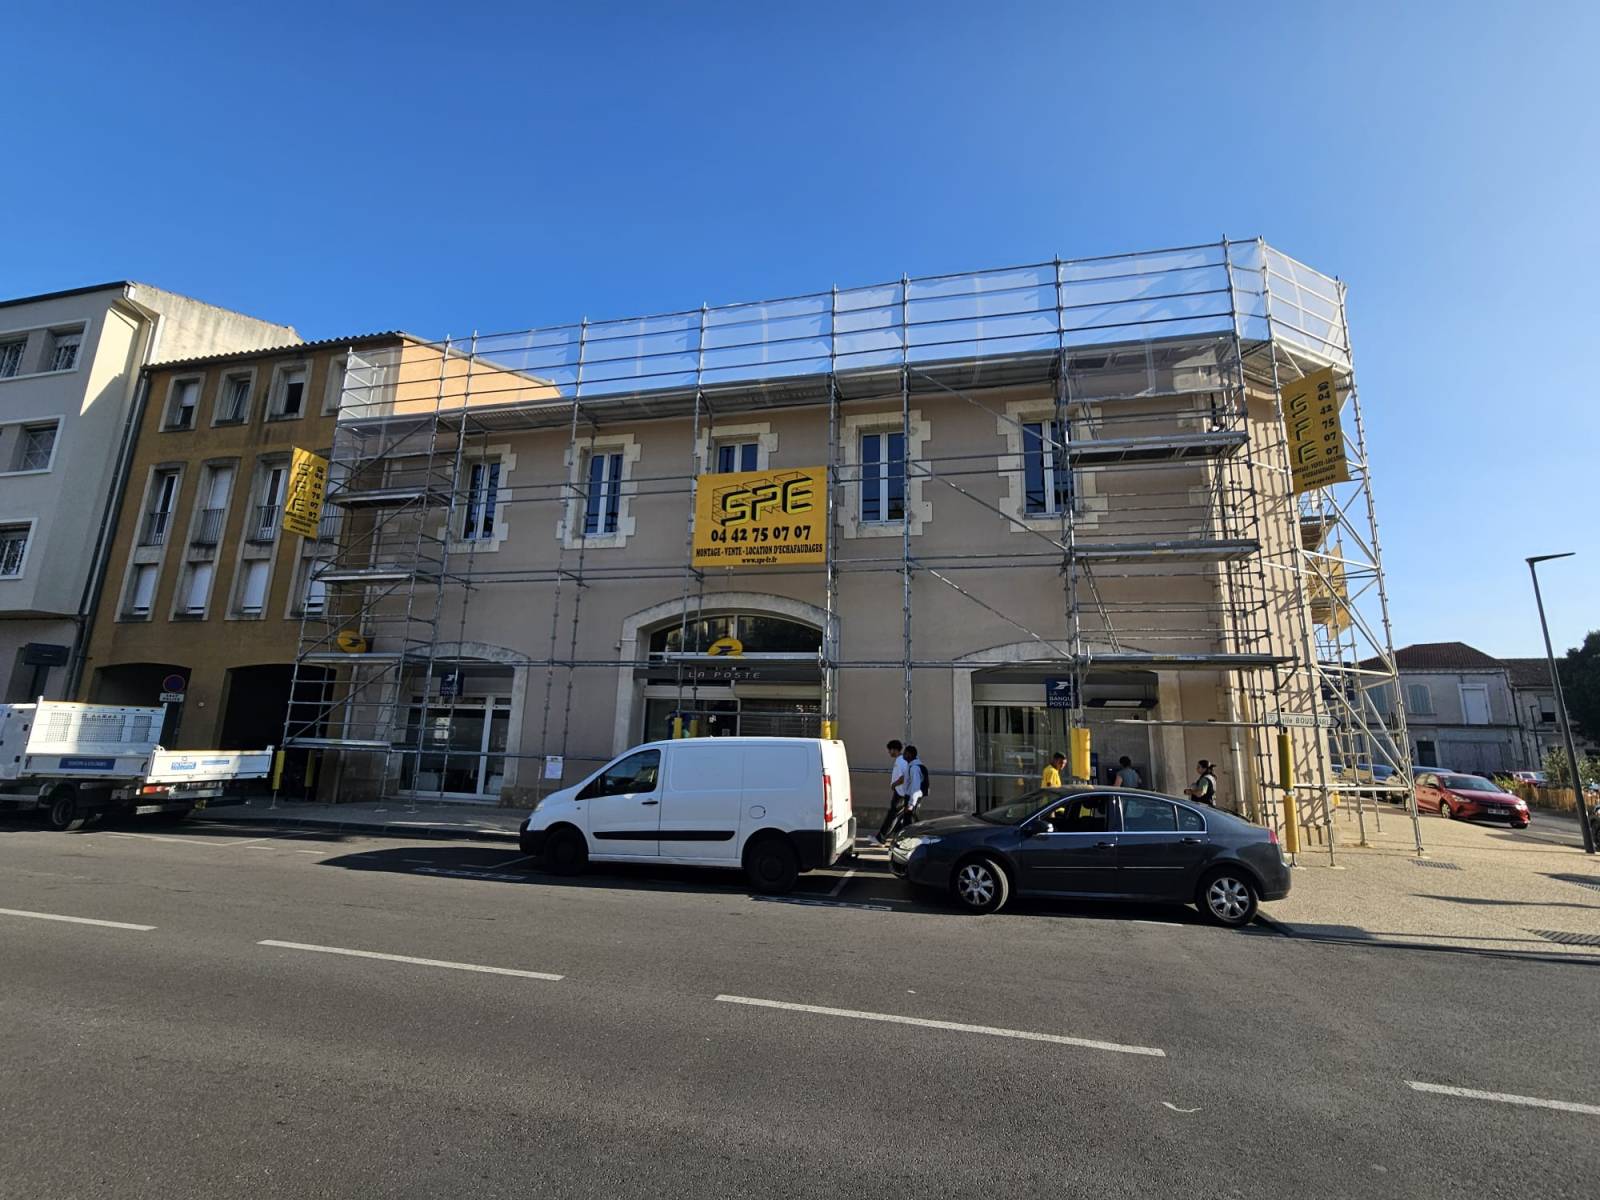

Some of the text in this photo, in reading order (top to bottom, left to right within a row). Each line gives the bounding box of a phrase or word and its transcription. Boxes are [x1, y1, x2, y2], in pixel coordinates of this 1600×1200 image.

[1317, 391, 1331, 401] 04
[1319, 404, 1333, 415] 42
[1321, 418, 1335, 429] 75
[1323, 432, 1337, 442] 07
[1325, 445, 1339, 455] 07
[720, 477, 813, 527] SPE
[711, 525, 812, 543] 04 42 75 07 07
[696, 543, 823, 557] MONTAGE VENTE LOCATION D'ECHAFAUDAGES
